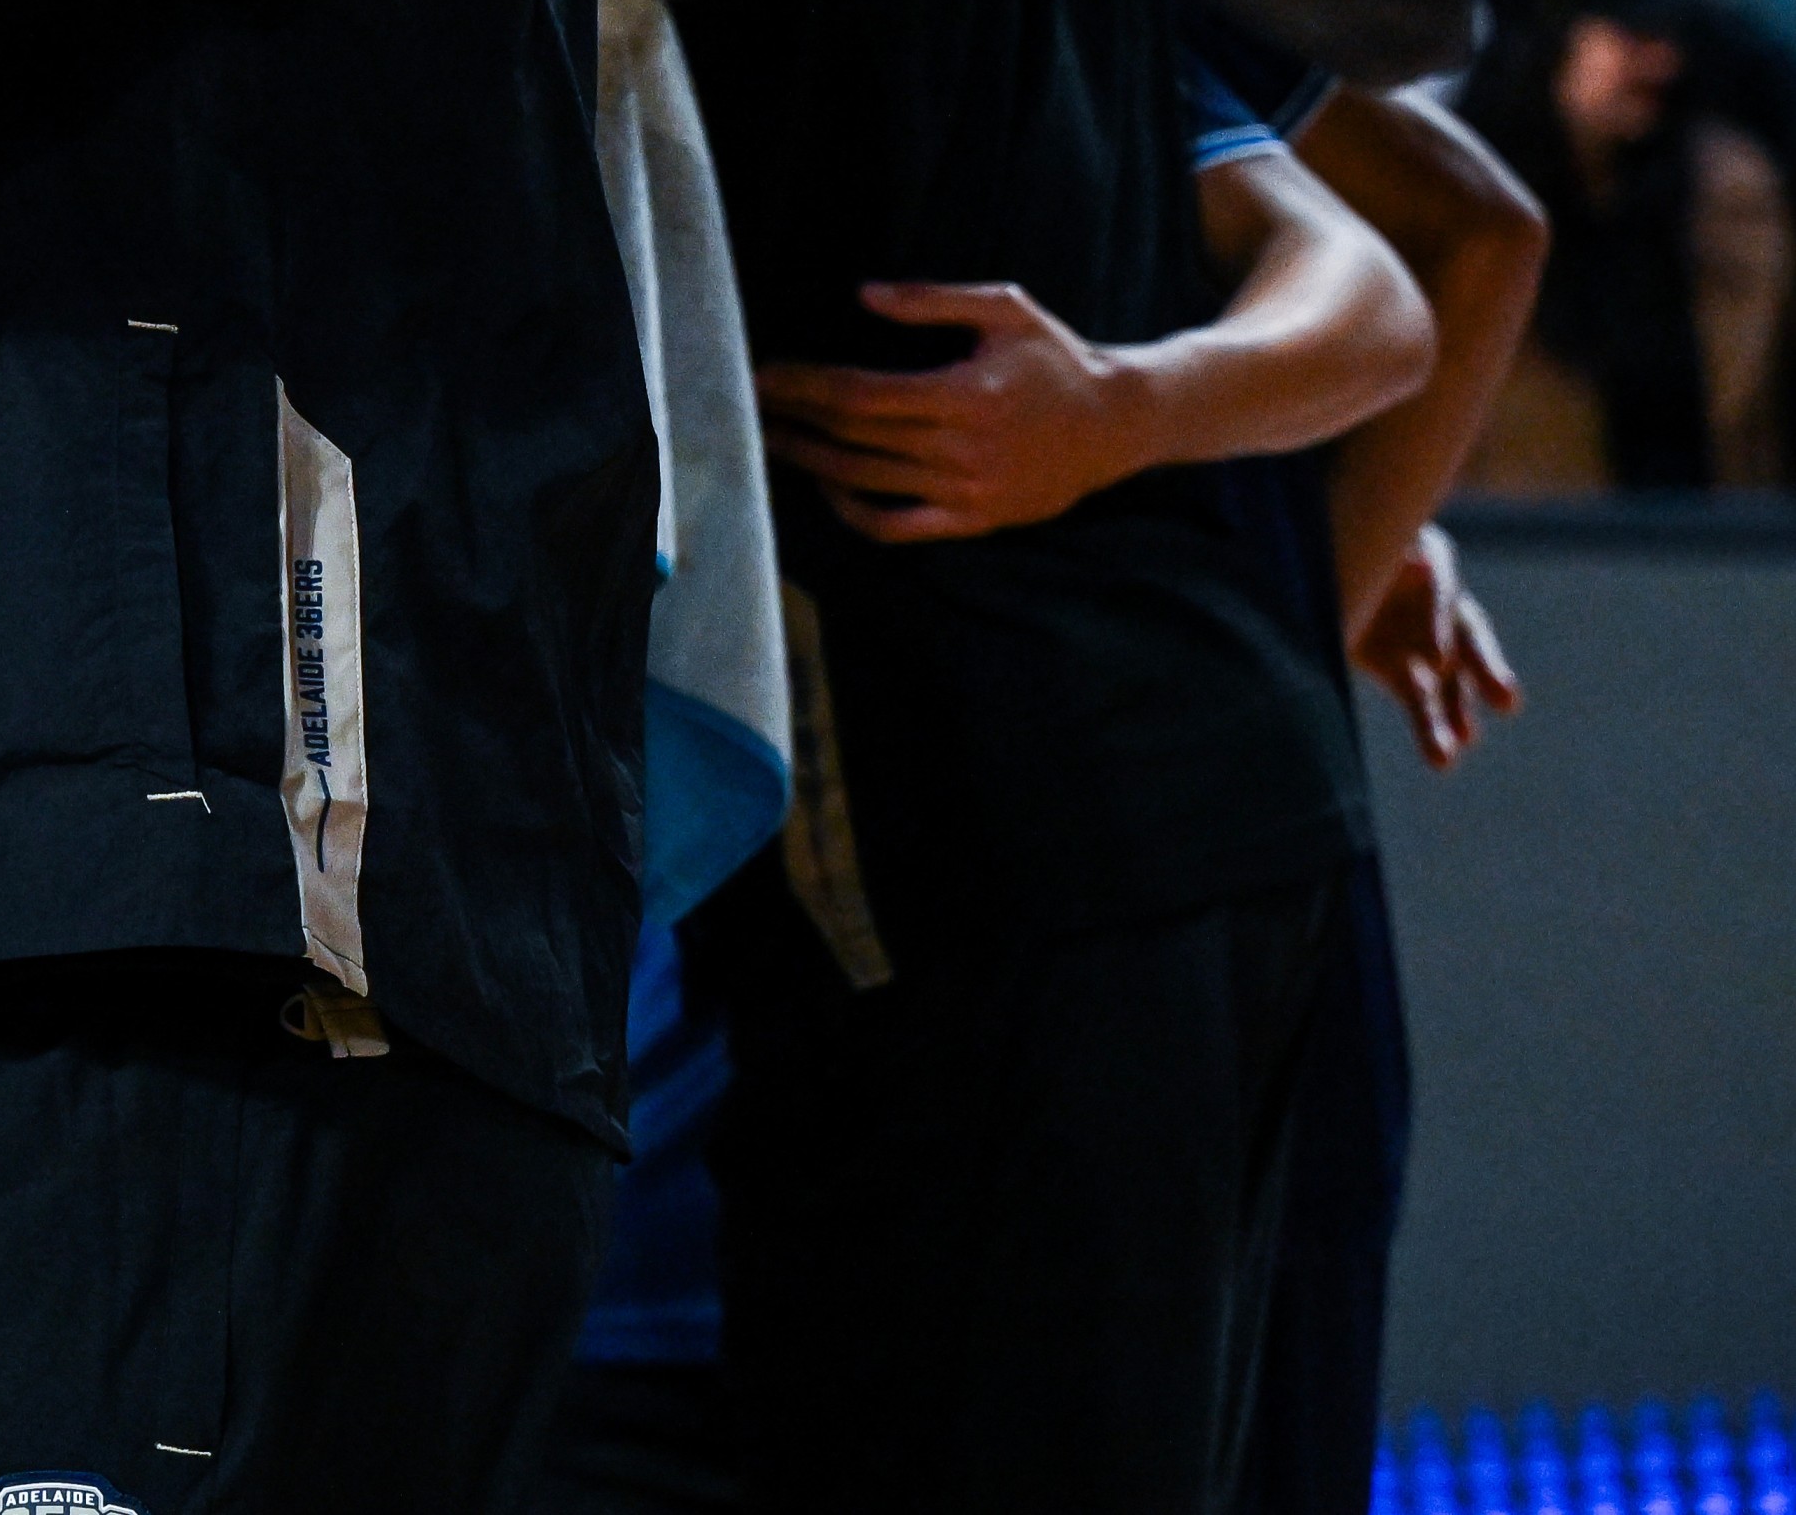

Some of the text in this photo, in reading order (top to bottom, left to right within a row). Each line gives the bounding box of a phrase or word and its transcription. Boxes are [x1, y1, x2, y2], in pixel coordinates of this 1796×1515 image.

[294, 558, 332, 768] ADELAIDE 36ERS
[5, 1489, 96, 1507] ADELAIDE
